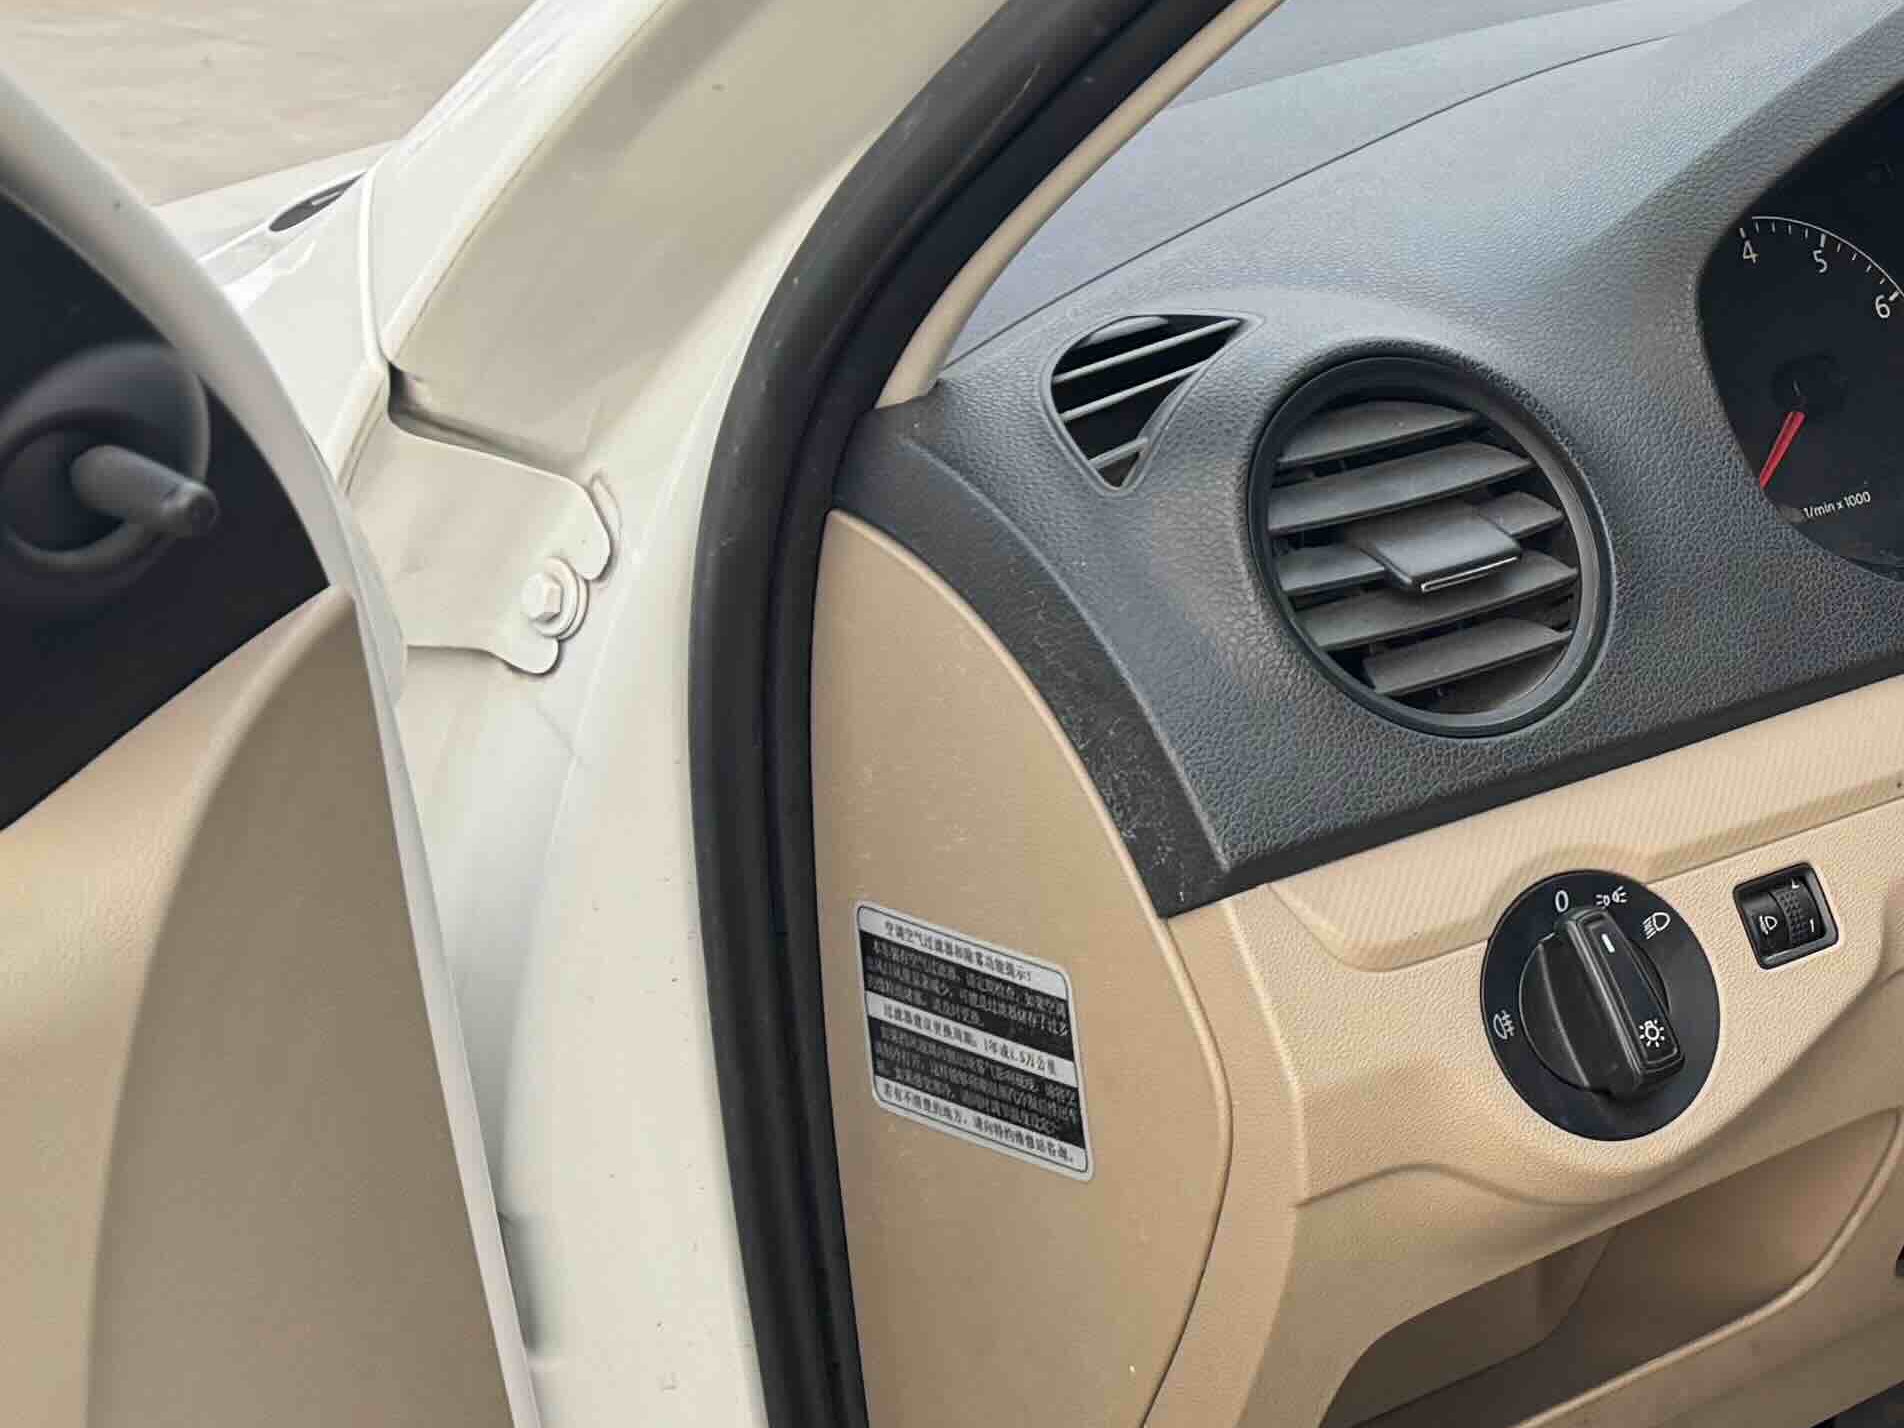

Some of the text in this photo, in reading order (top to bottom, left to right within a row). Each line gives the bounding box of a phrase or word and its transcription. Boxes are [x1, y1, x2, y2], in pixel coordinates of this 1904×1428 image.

[1742, 240, 1759, 264] 4
[1812, 249, 1828, 273] 5
[1874, 294, 1891, 319] 6
[1843, 491, 1872, 508] 1000
